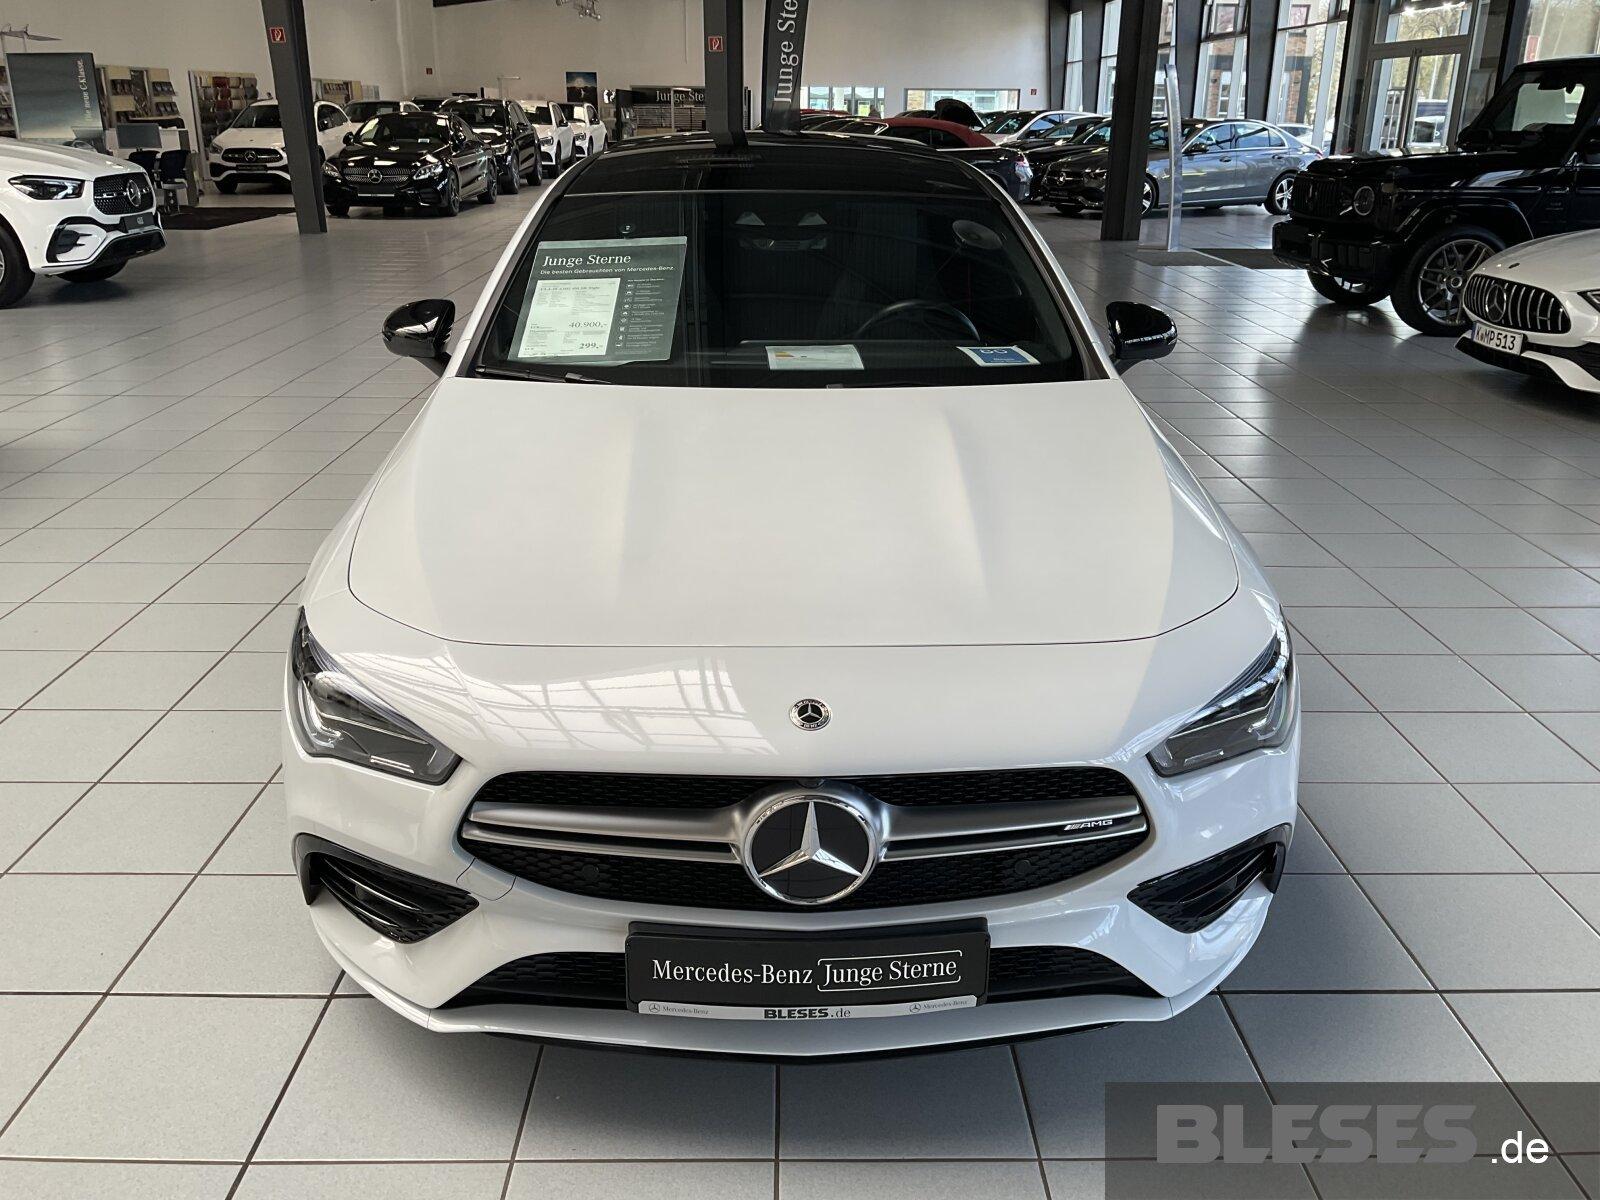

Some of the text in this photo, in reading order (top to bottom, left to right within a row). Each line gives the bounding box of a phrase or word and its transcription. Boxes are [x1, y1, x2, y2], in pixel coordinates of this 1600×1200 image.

[773, 41, 799, 103] Junge
[656, 91, 686, 103] Junge
[542, 254, 632, 268] Junge Sterne
[1495, 333, 1516, 351] 513
[1079, 819, 1113, 829] AMG
[652, 959, 957, 986] Mercedes-Benz Junge Sterne
[662, 1006, 709, 1015] Mercedes-Benz
[923, 999, 968, 1009] Mercedes-Benz
